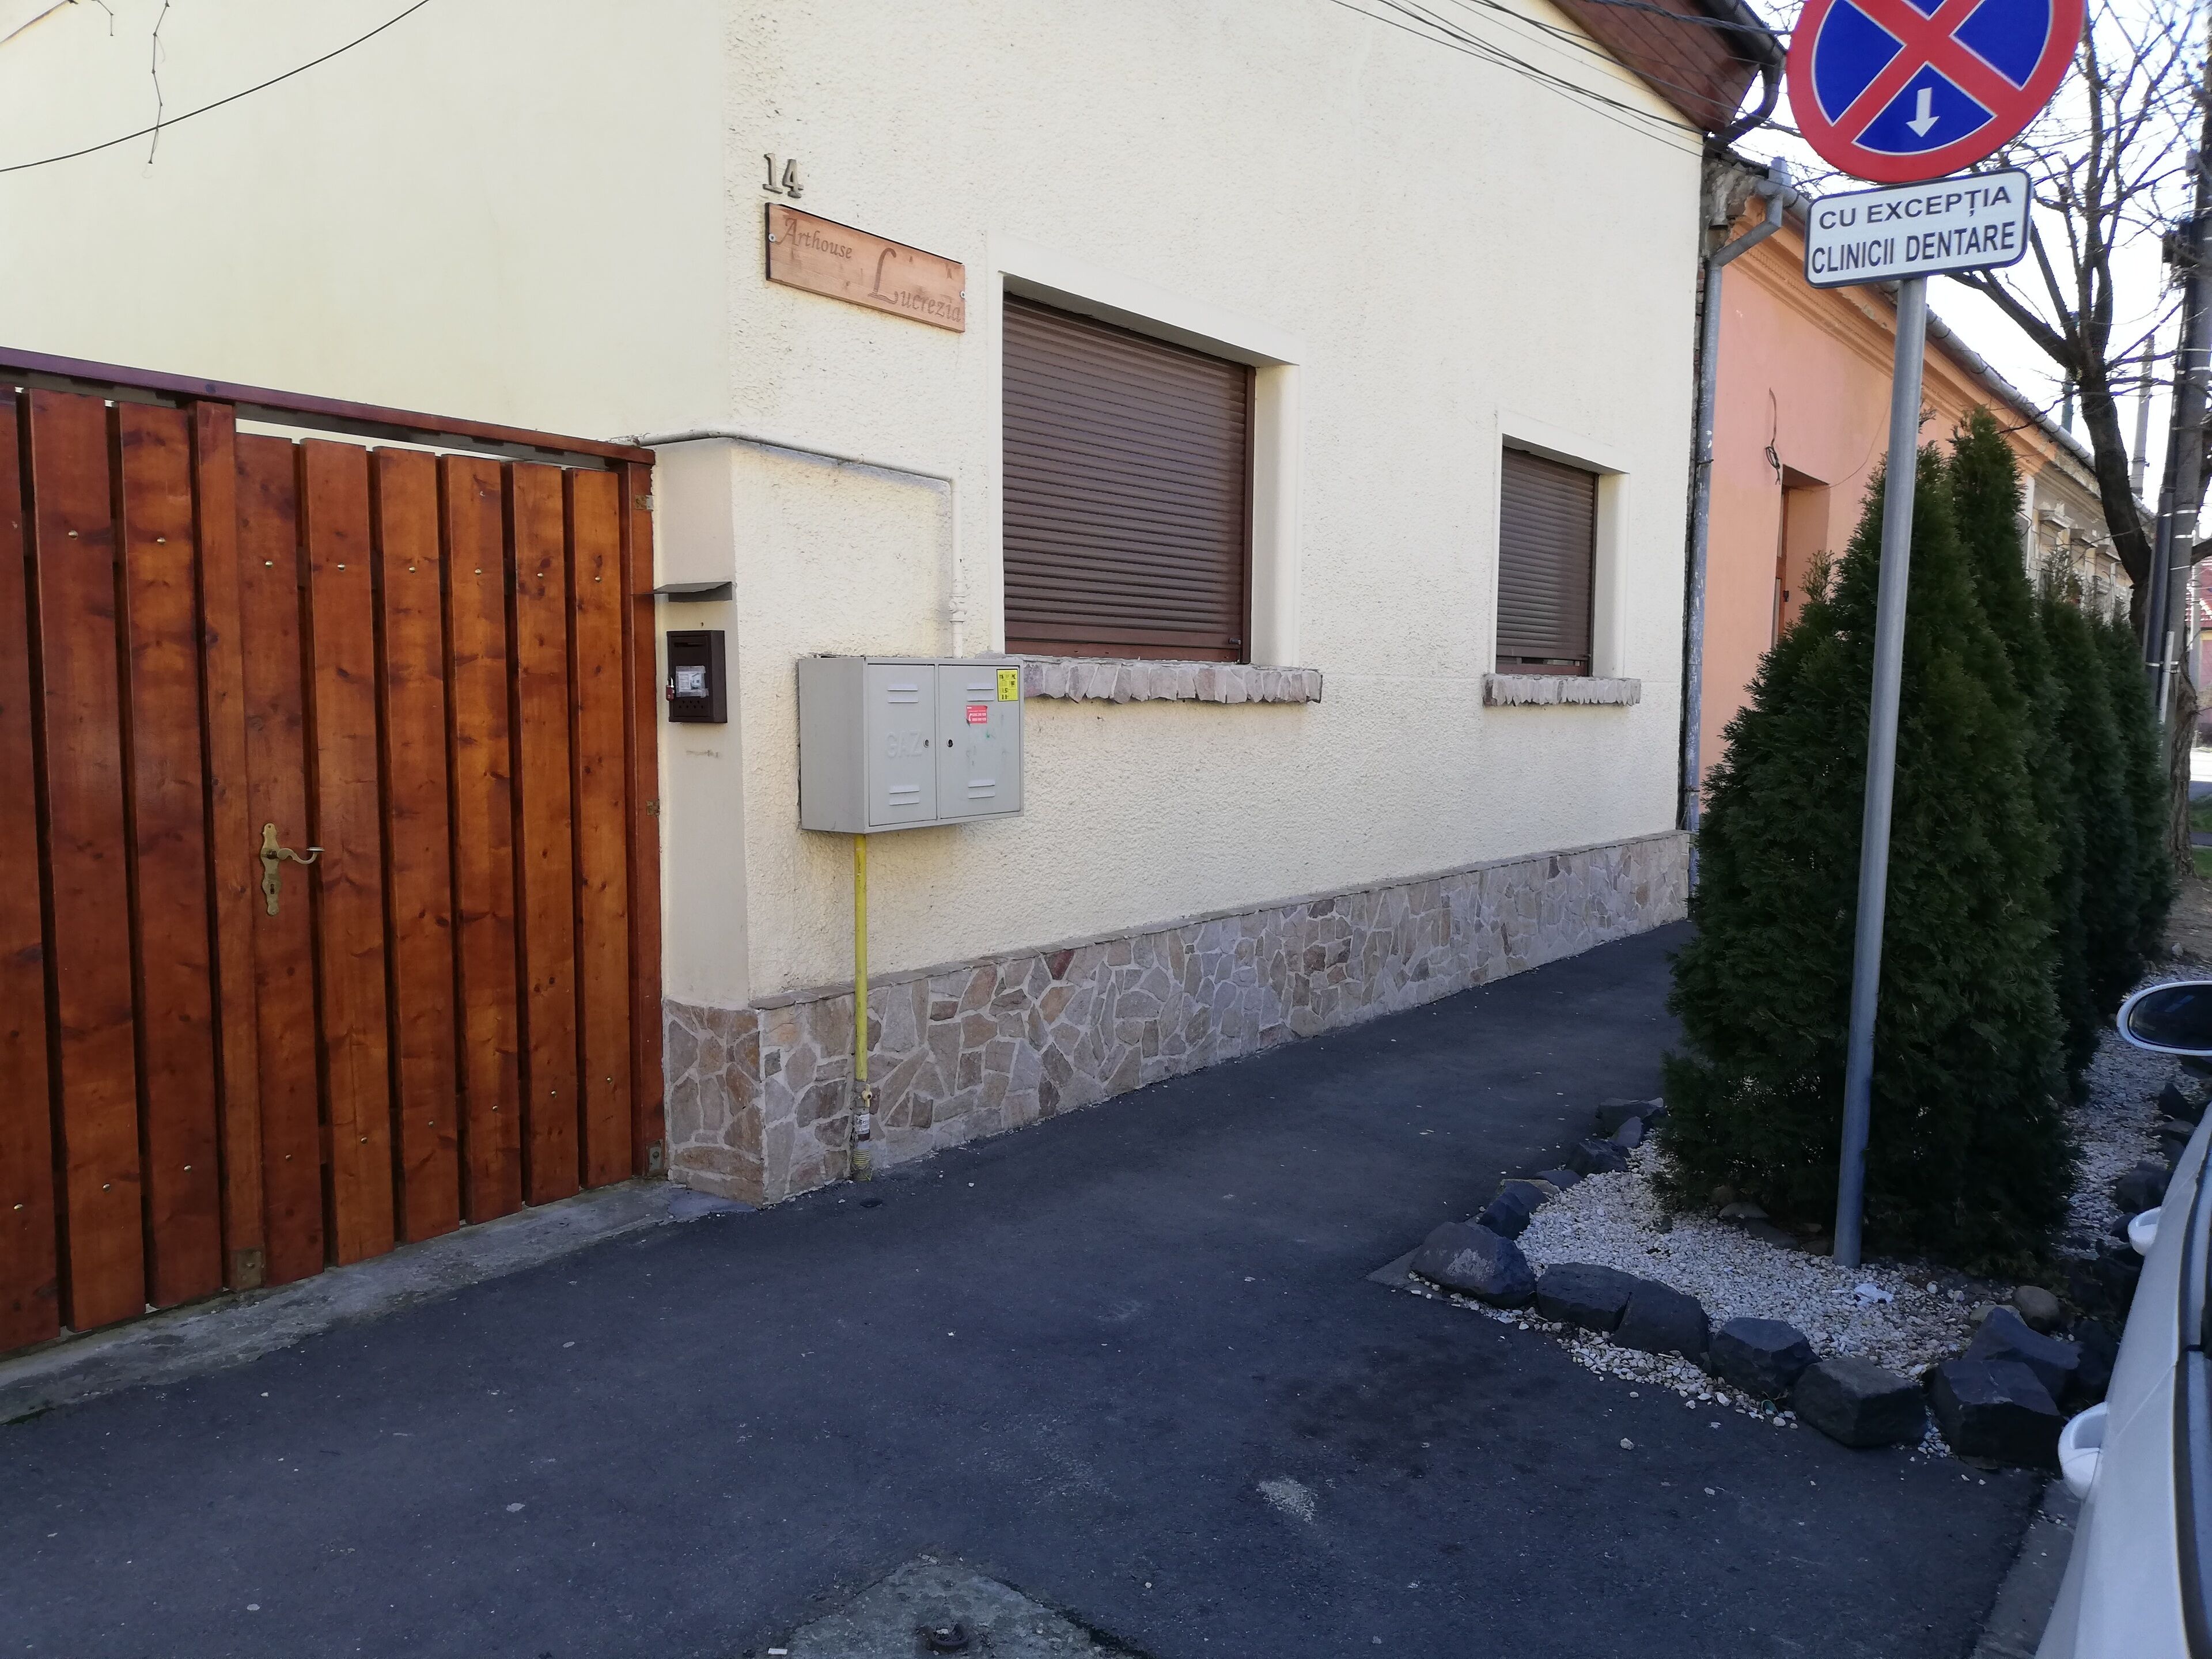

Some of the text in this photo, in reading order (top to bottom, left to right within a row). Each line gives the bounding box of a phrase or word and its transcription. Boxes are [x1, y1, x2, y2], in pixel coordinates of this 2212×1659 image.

[763, 153, 804, 198] 14
[1819, 186, 2012, 230] CU EXCEPȚIA
[776, 218, 853, 259] Arthouse
[1812, 221, 2015, 274] CLINICII DENTARE
[868, 248, 961, 321] Lucrezia
